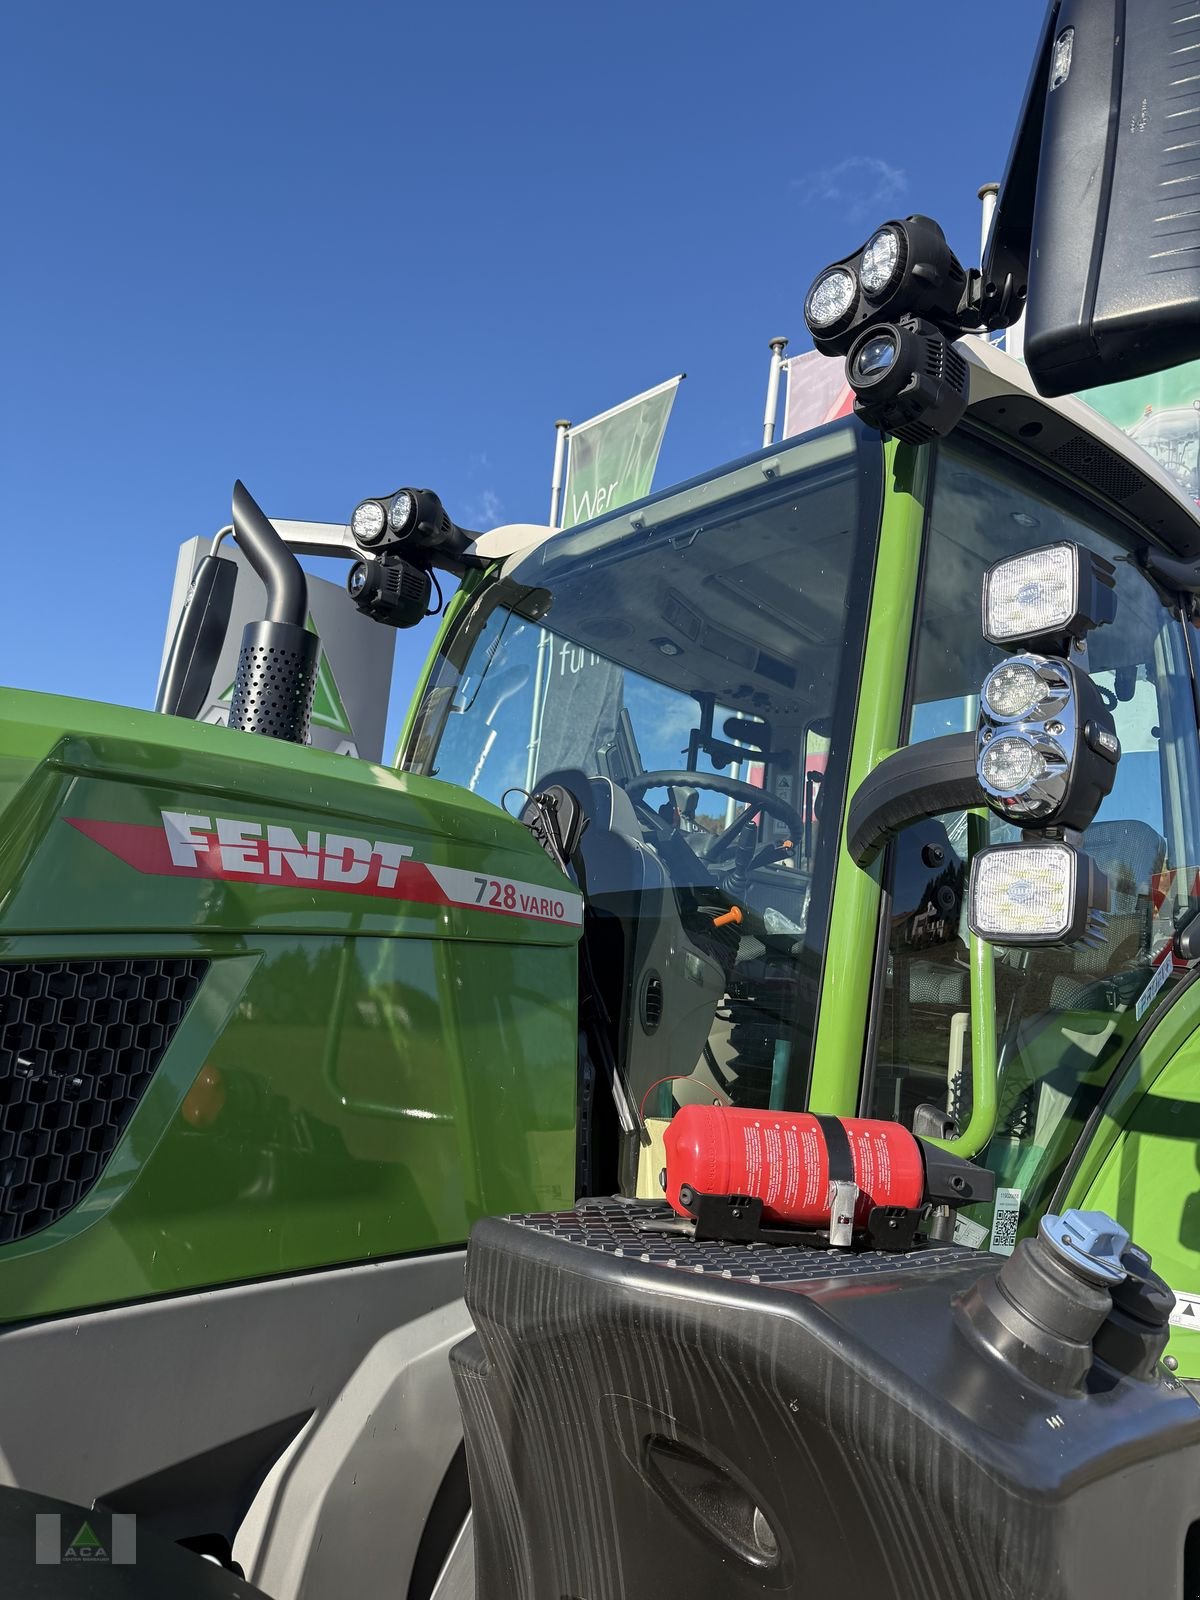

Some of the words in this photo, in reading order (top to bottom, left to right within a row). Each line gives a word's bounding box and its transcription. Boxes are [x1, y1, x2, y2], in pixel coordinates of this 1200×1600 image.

[572, 480, 619, 525] Wer
[160, 810, 414, 889] FENDT
[473, 877, 517, 910] 728
[519, 894, 565, 919] VARIO
